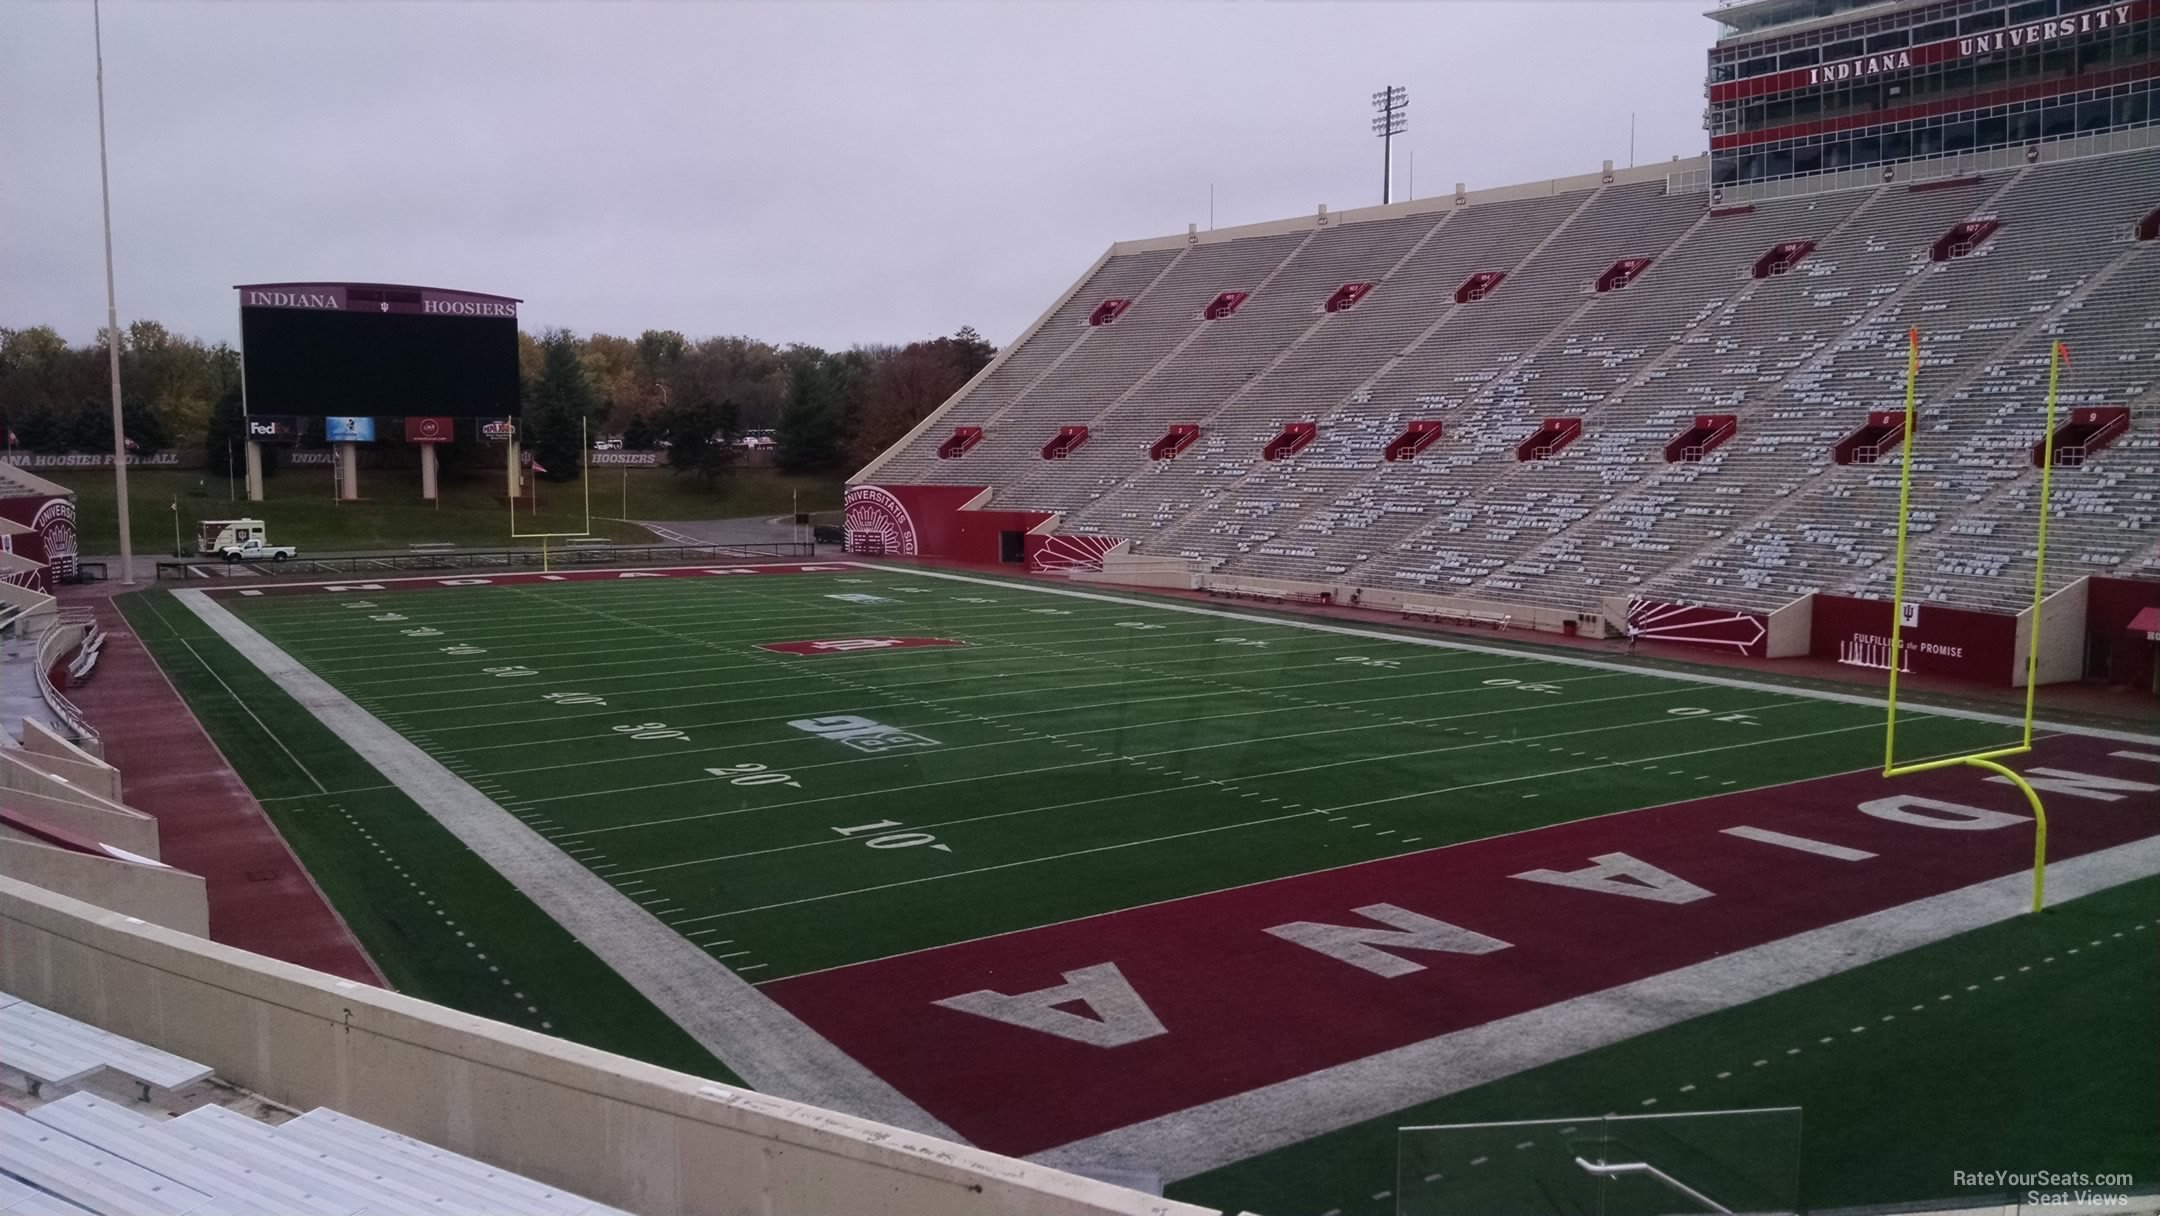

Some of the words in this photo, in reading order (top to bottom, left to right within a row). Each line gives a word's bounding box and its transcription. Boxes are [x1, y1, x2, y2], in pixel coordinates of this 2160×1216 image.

[1811, 52, 1911, 85] INDIANA
[1960, 6, 2131, 56] UNIVERSITY
[1966, 224, 1980, 232] 107
[249, 291, 339, 310] INDIANA
[424, 300, 515, 317] HOOSIERS
[1707, 419, 1714, 427] 7
[1882, 415, 1890, 424] 8
[2089, 412, 2097, 422] 9
[251, 422, 290, 434] FedEx
[34, 455, 101, 466] HOOSIER
[591, 453, 656, 464] HOOSIERS
[1854, 633, 1904, 649] FULFILLIG
[1906, 641, 1918, 650] the
[1920, 642, 1963, 658] PROMISE
[541, 692, 604, 705] 40
[1667, 707, 1762, 726] 10
[612, 722, 685, 741] 30
[704, 763, 792, 786] 20
[830, 818, 937, 849] 10
